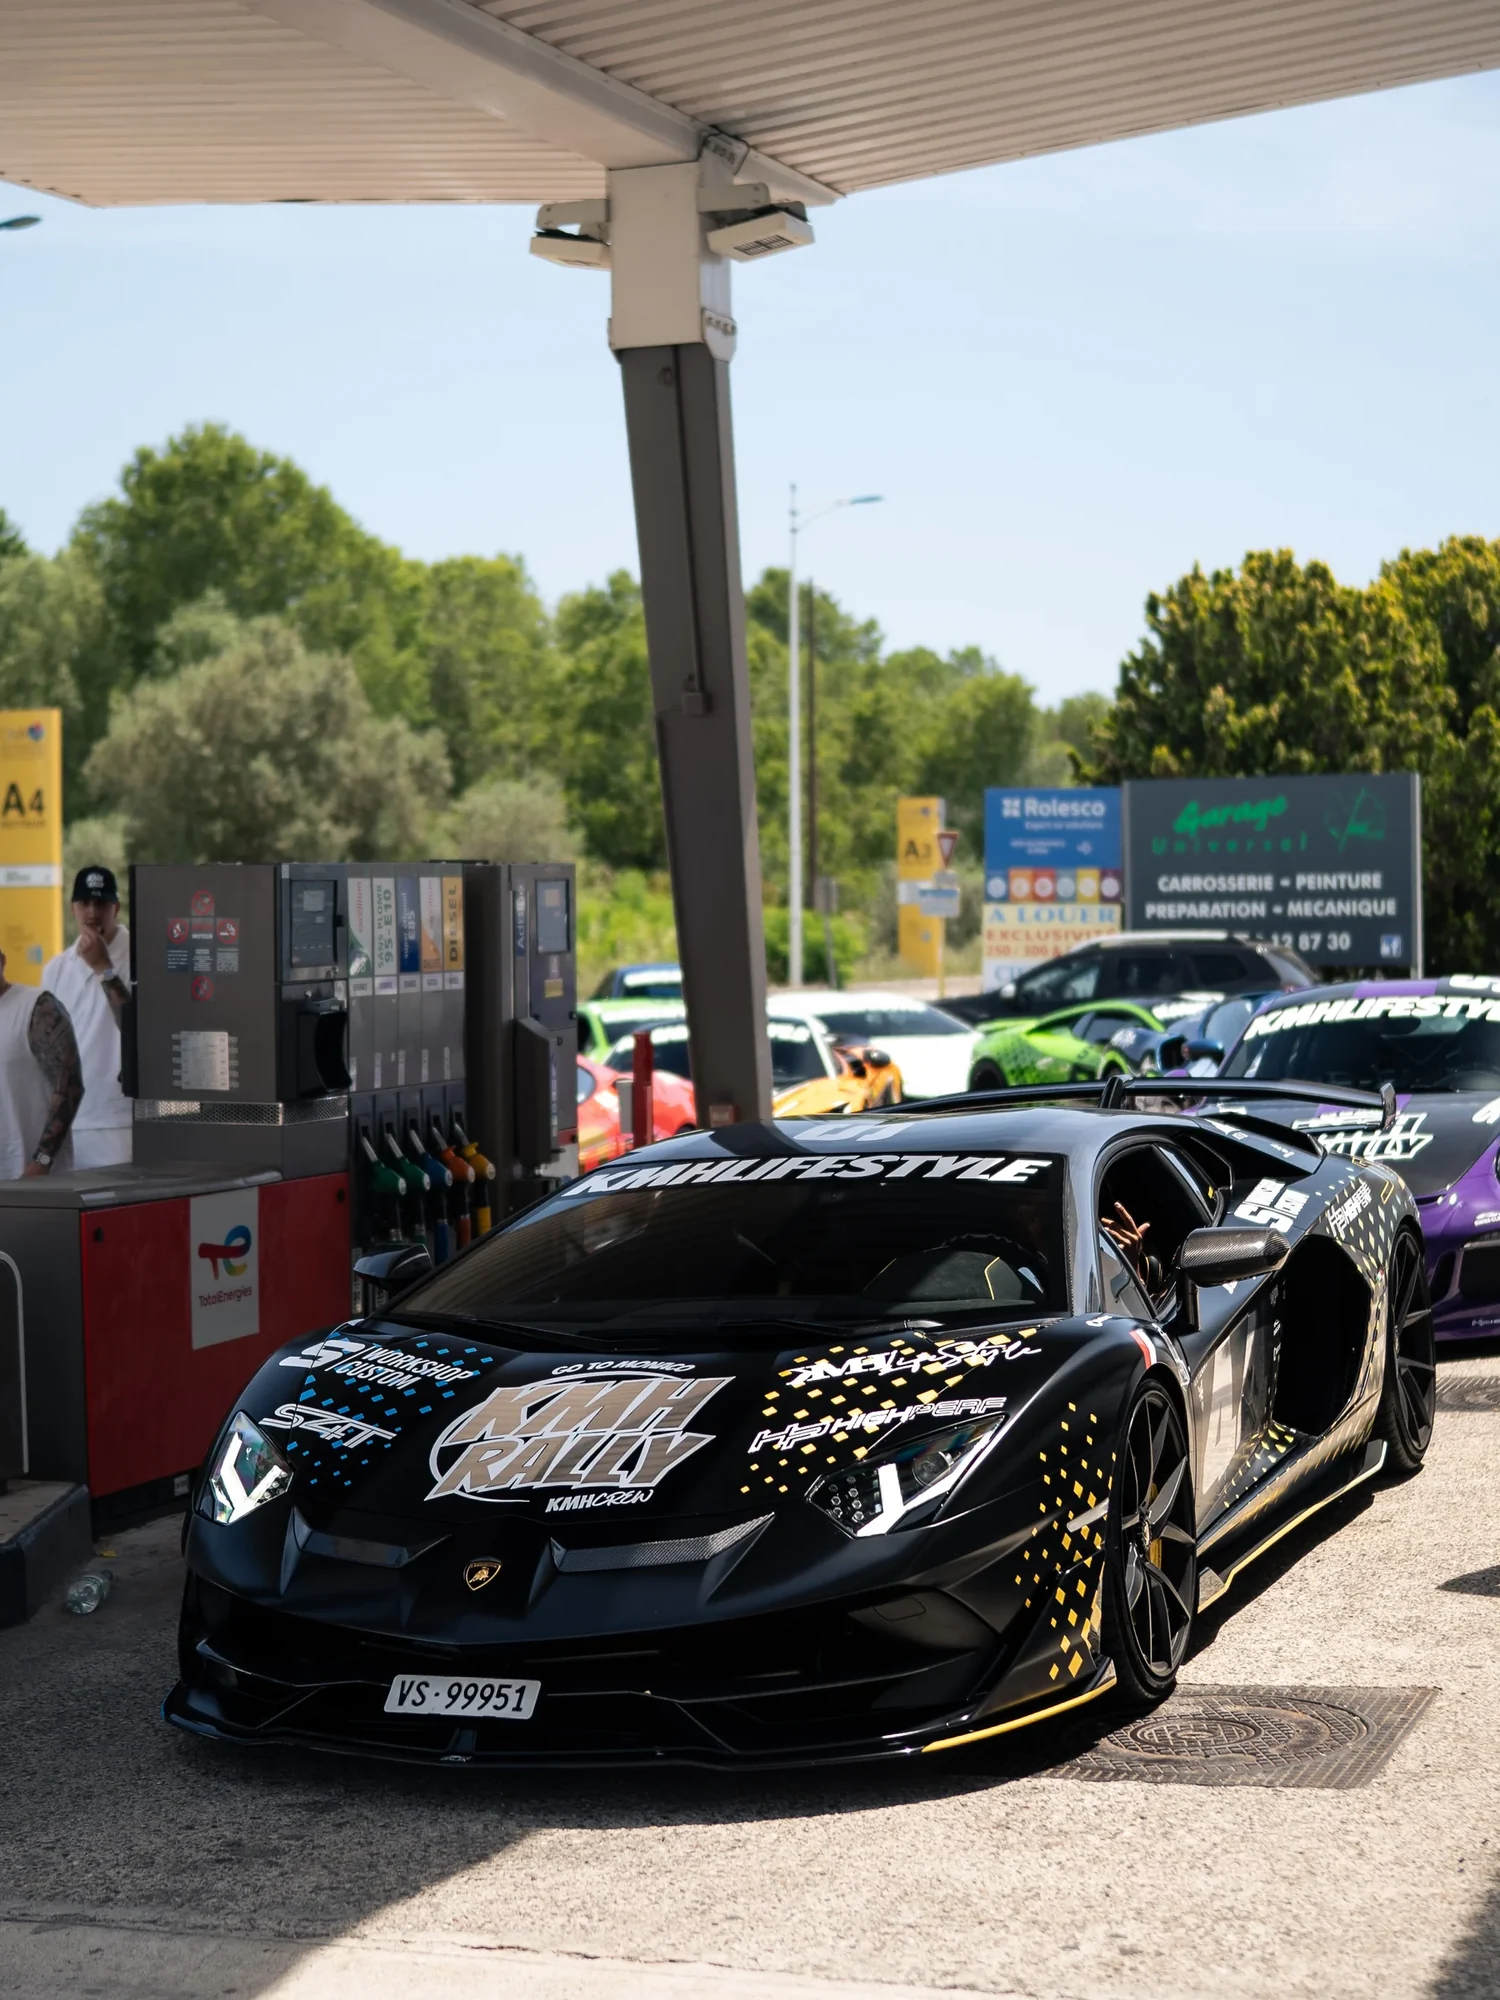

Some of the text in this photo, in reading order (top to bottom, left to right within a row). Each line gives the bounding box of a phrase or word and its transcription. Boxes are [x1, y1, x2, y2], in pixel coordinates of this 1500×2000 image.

[2, 781, 45, 817] A4
[1024, 797, 1106, 818] Rolesco
[1173, 795, 1287, 836] Garage
[1158, 874, 1274, 892] CARROSSERIE
[1296, 872, 1383, 891] PEINTURE
[448, 884, 458, 962] DIESEL
[1017, 907, 1116, 923] LOUER
[1146, 902, 1267, 919] PREPARATION
[1287, 899, 1397, 918] MECANIQUE
[383, 889, 393, 963] 95-E10
[1327, 932, 1351, 951] 30
[561, 1155, 1053, 1198] KMHLIFESTYLE
[198, 1285, 253, 1308] TotalEnergies
[337, 1360, 421, 1390] CUSTOM
[362, 1345, 474, 1382] WORKSHOP
[551, 1359, 696, 1376] GO TO MONACO
[442, 1376, 736, 1447] KMH
[423, 1432, 717, 1502] RALLY
